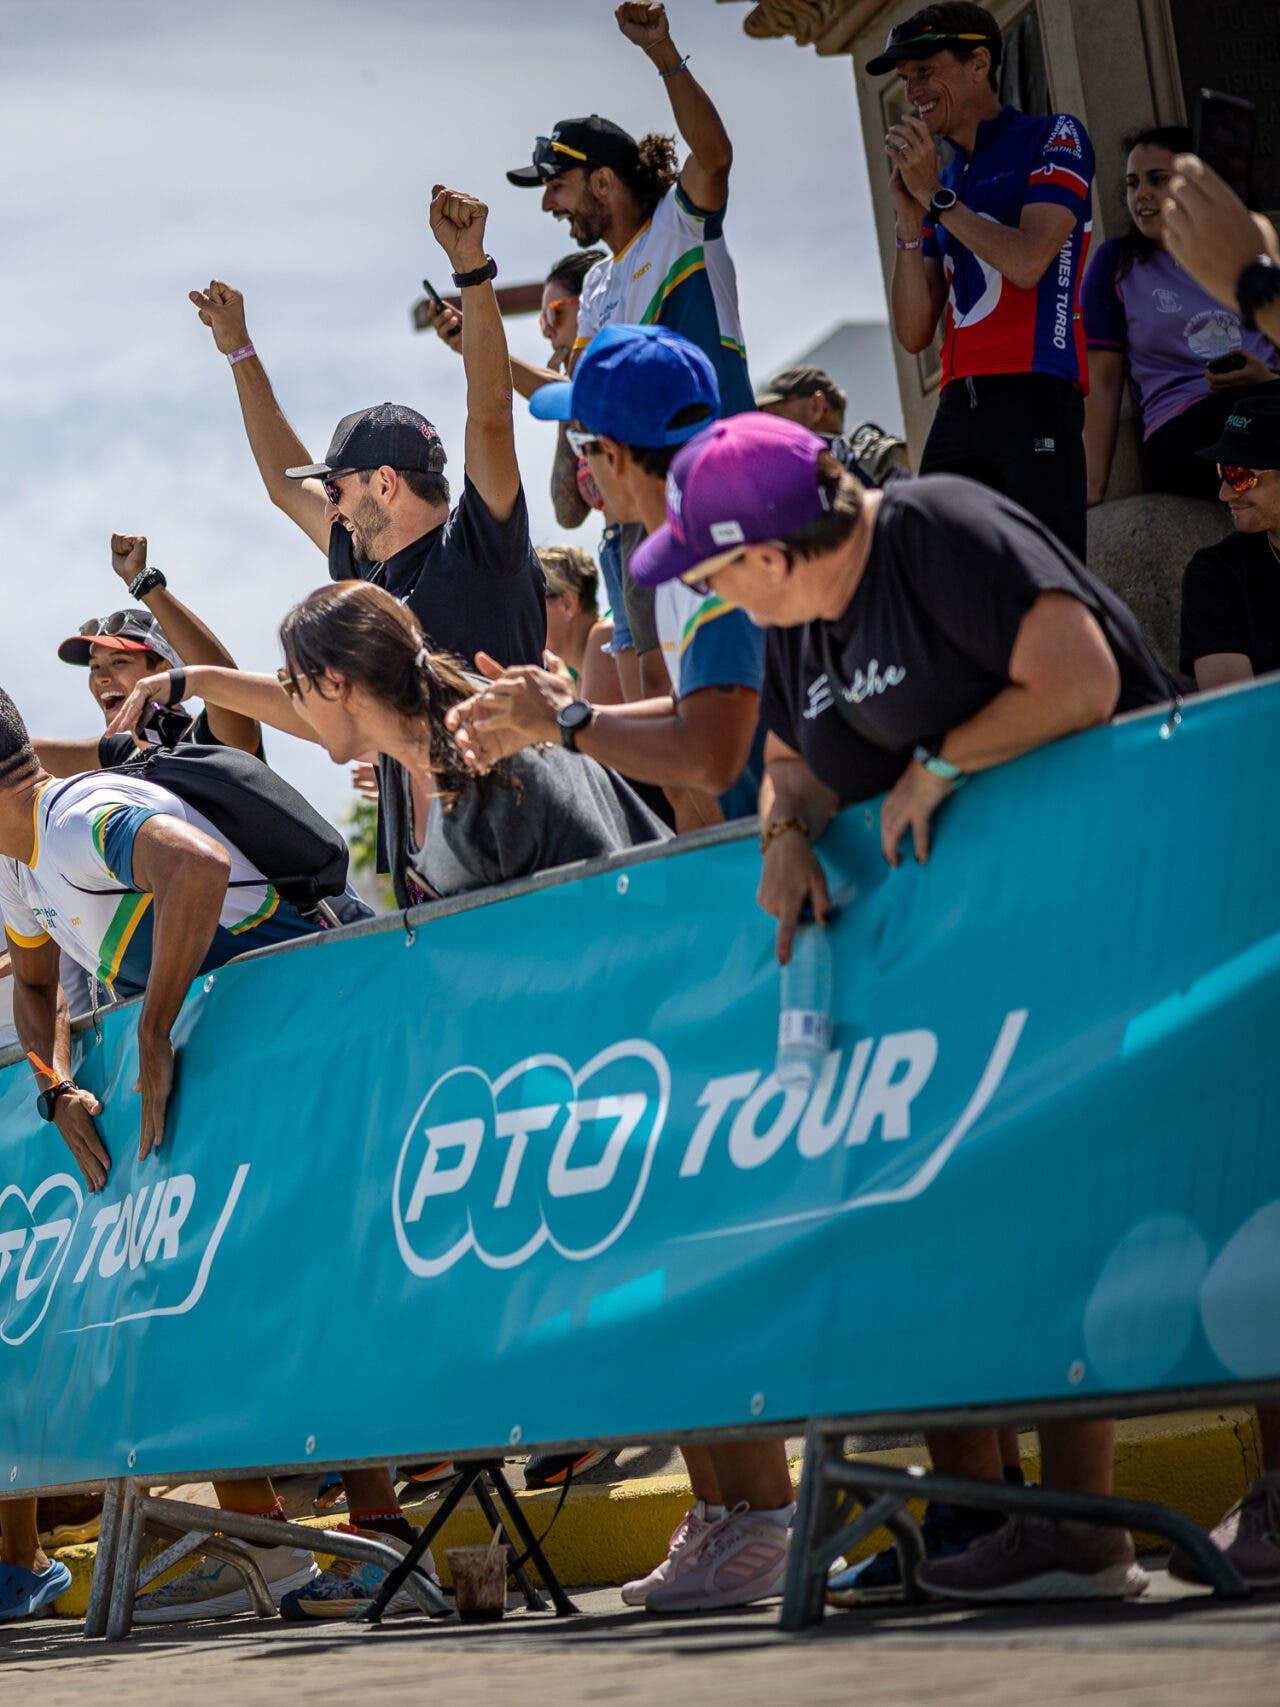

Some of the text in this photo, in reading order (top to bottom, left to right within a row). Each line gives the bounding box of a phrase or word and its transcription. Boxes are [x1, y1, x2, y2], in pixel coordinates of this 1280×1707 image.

[1053, 293, 1068, 349] TURBO
[404, 1029, 939, 1223] PTO TOUR
[72, 1174, 197, 1284] TOUR
